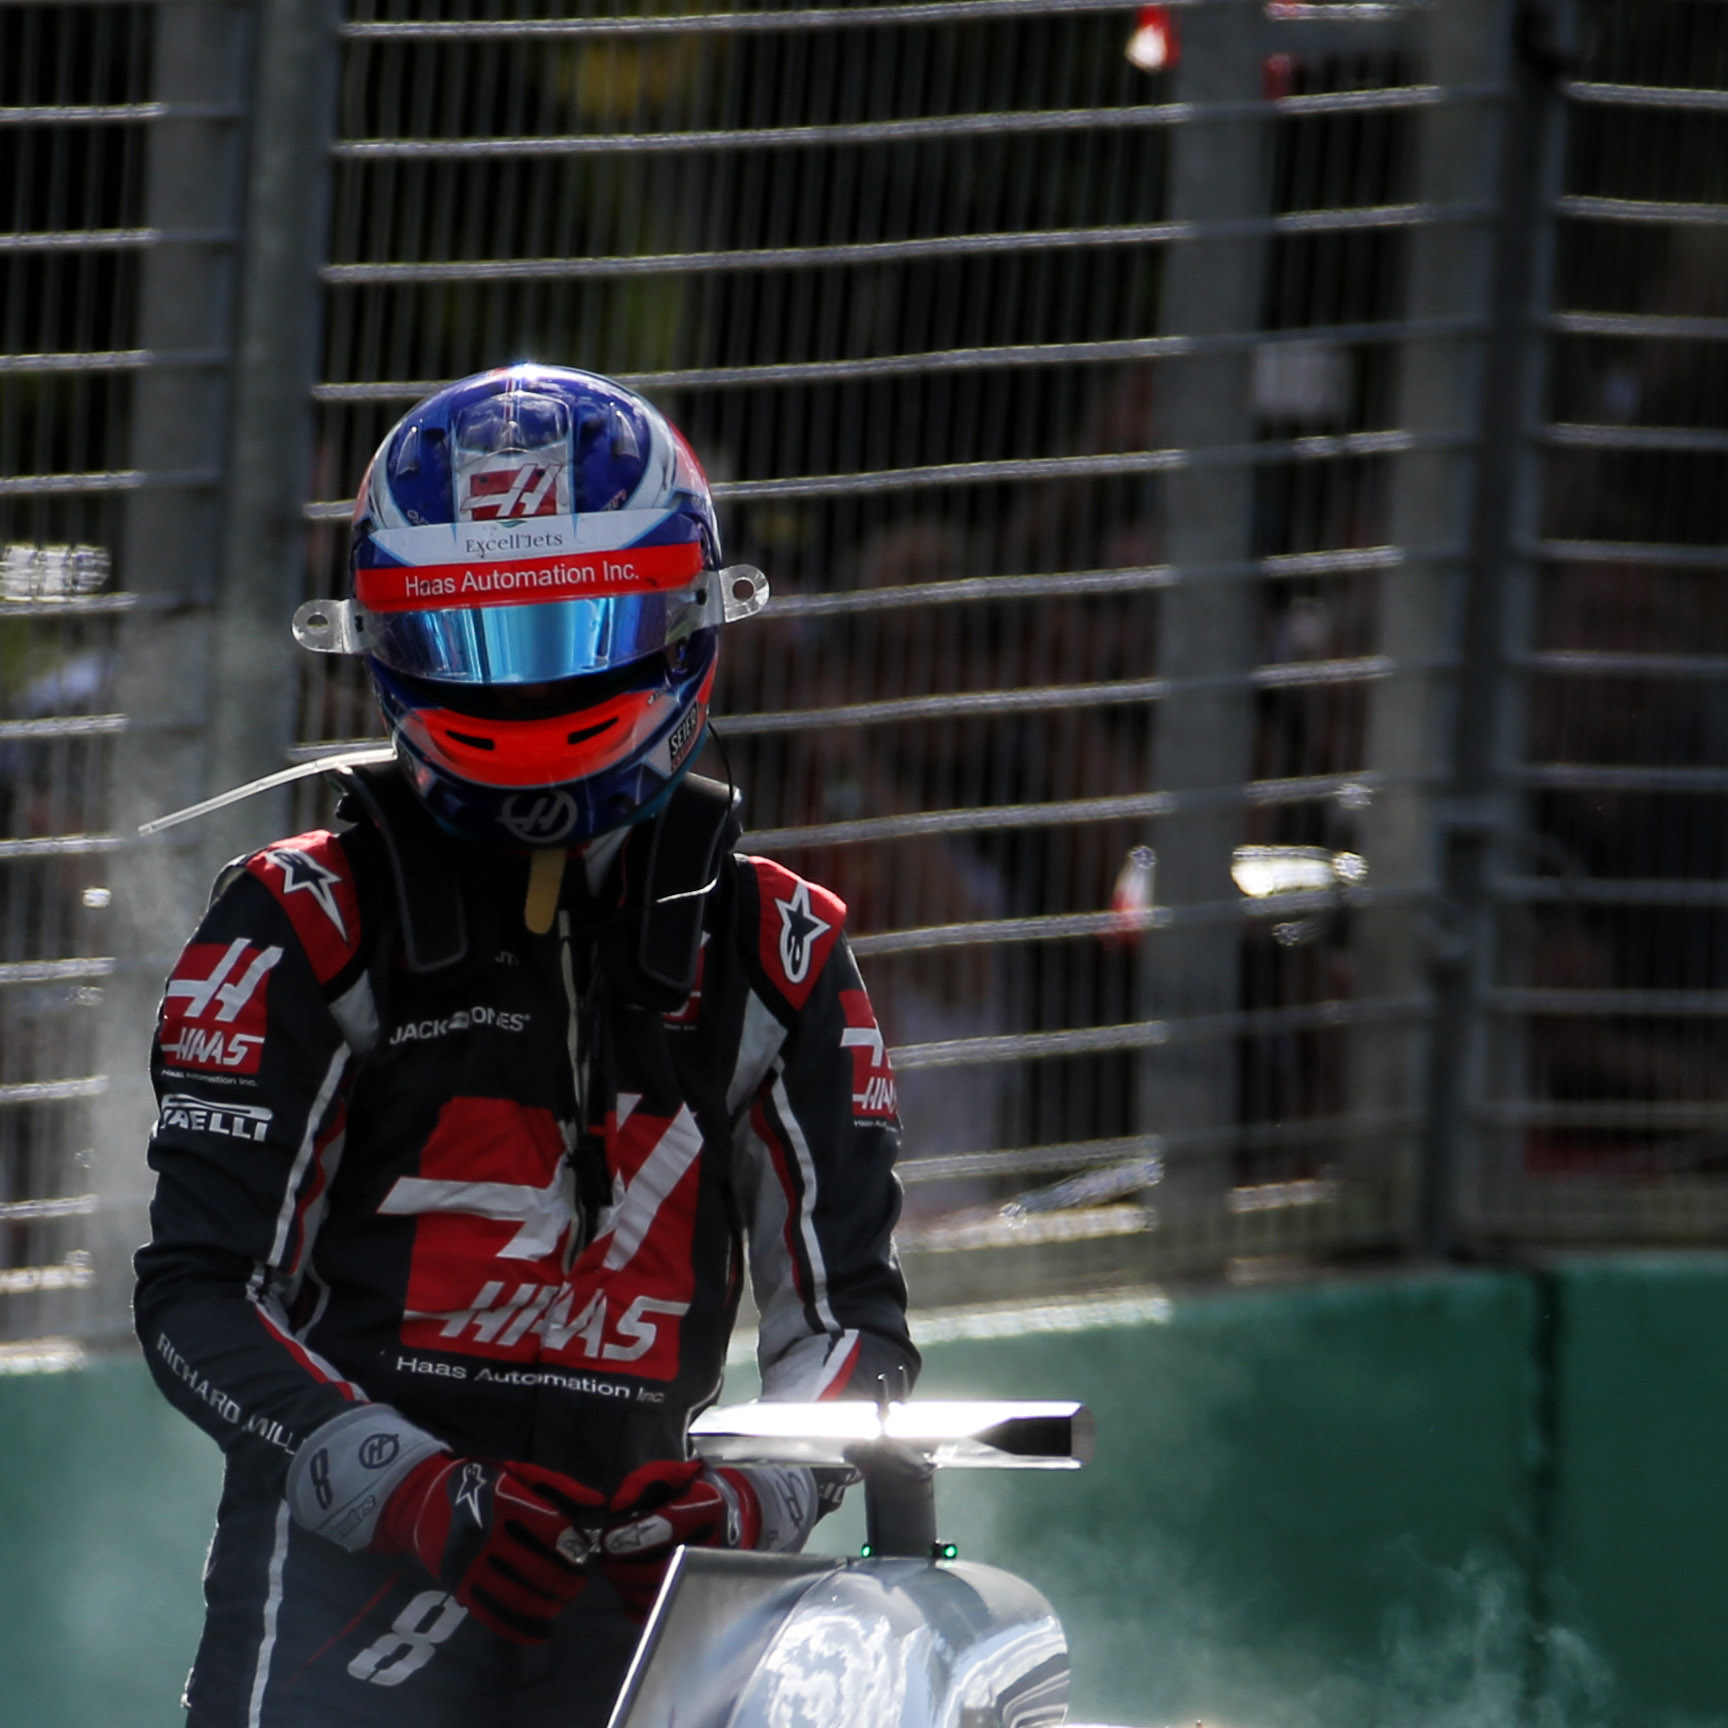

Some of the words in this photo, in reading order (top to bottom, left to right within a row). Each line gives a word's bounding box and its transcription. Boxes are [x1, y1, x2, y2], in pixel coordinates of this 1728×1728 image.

[404, 574, 456, 599] Haas
[460, 564, 595, 594] Automation
[602, 559, 640, 582] Inc.
[160, 1027, 266, 1067] HAAS
[403, 1279, 692, 1362] HAAS
[156, 1331, 242, 1425] RICHARD
[396, 1355, 467, 1380] Haas
[473, 1366, 630, 1399] Automation
[347, 1589, 470, 1688] 8
